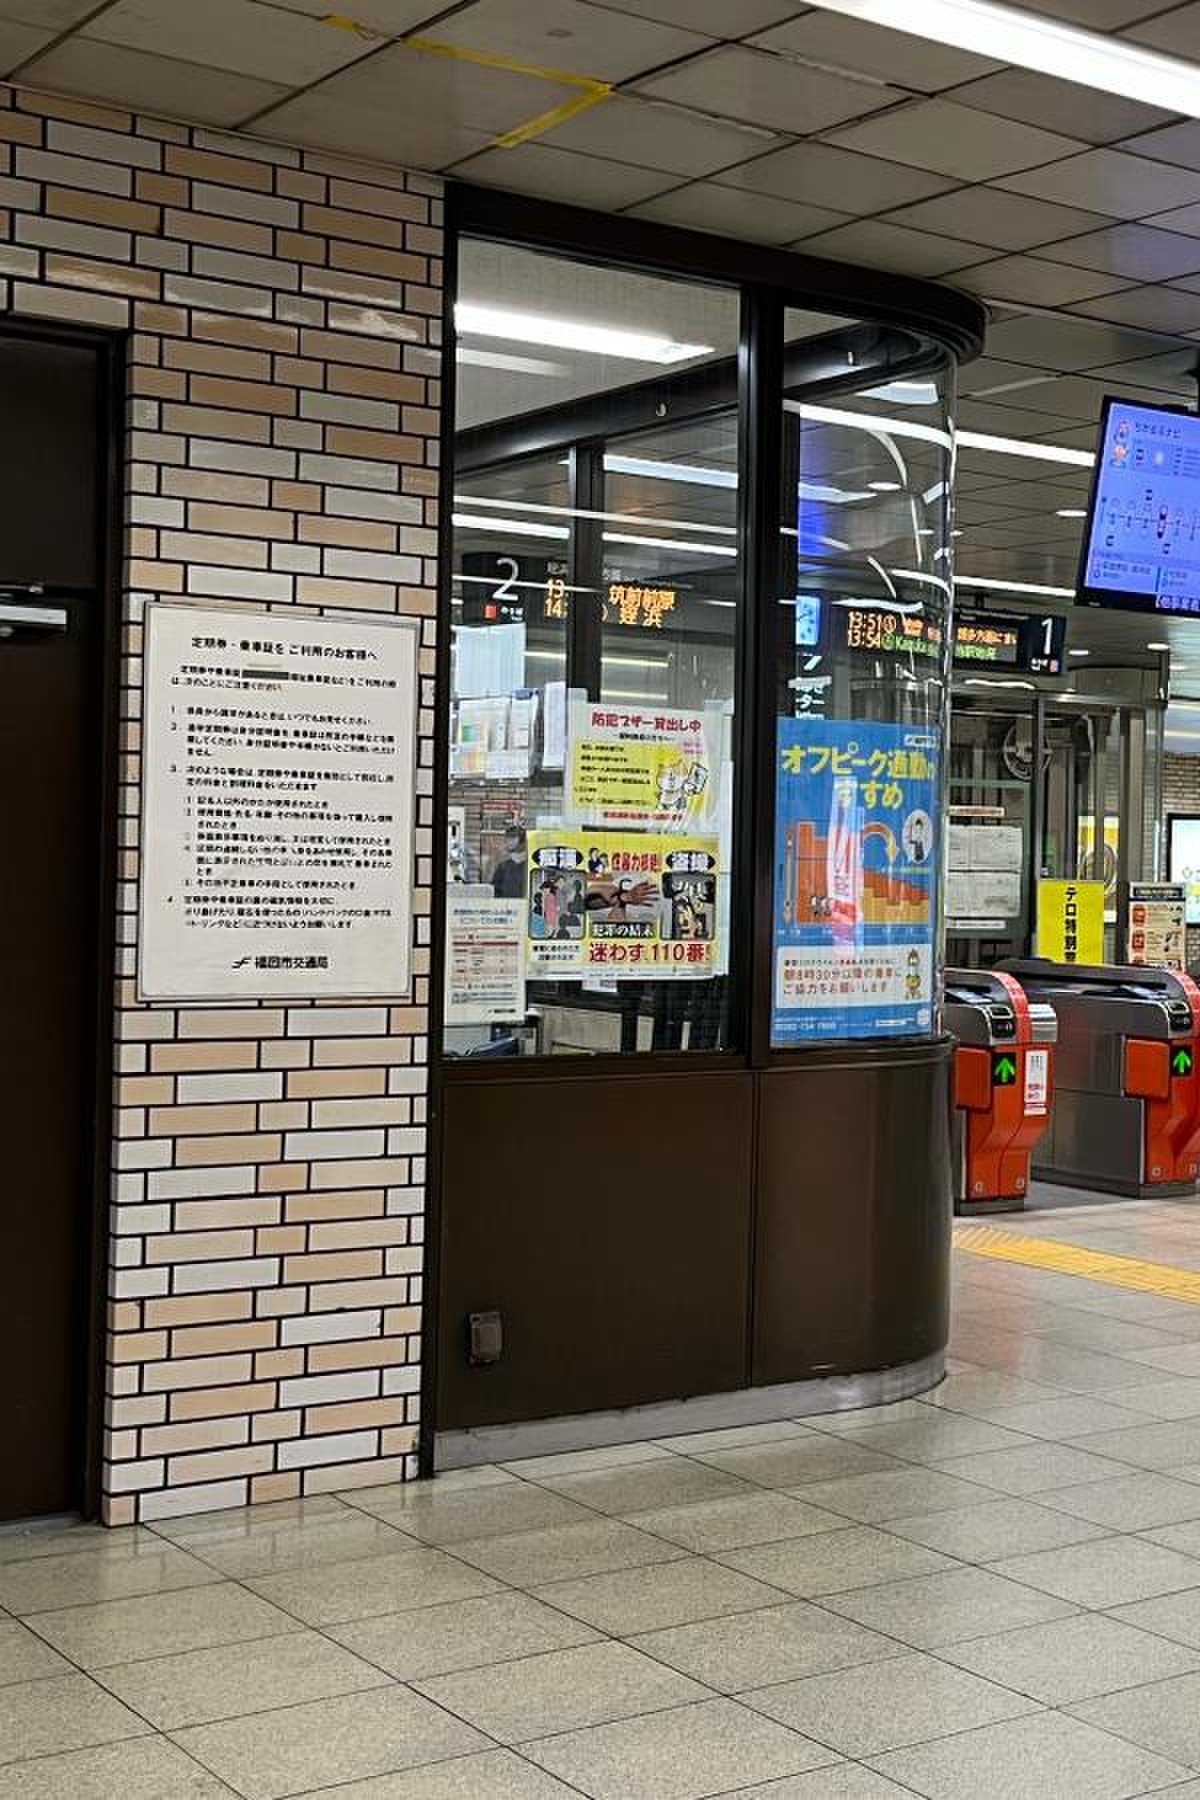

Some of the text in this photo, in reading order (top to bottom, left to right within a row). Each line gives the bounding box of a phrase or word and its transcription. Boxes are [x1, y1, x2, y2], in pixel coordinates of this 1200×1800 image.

[492, 557, 519, 601] 2
[1041, 617, 1053, 655] 1
[255, 956, 328, 969] 福岡市交通局
